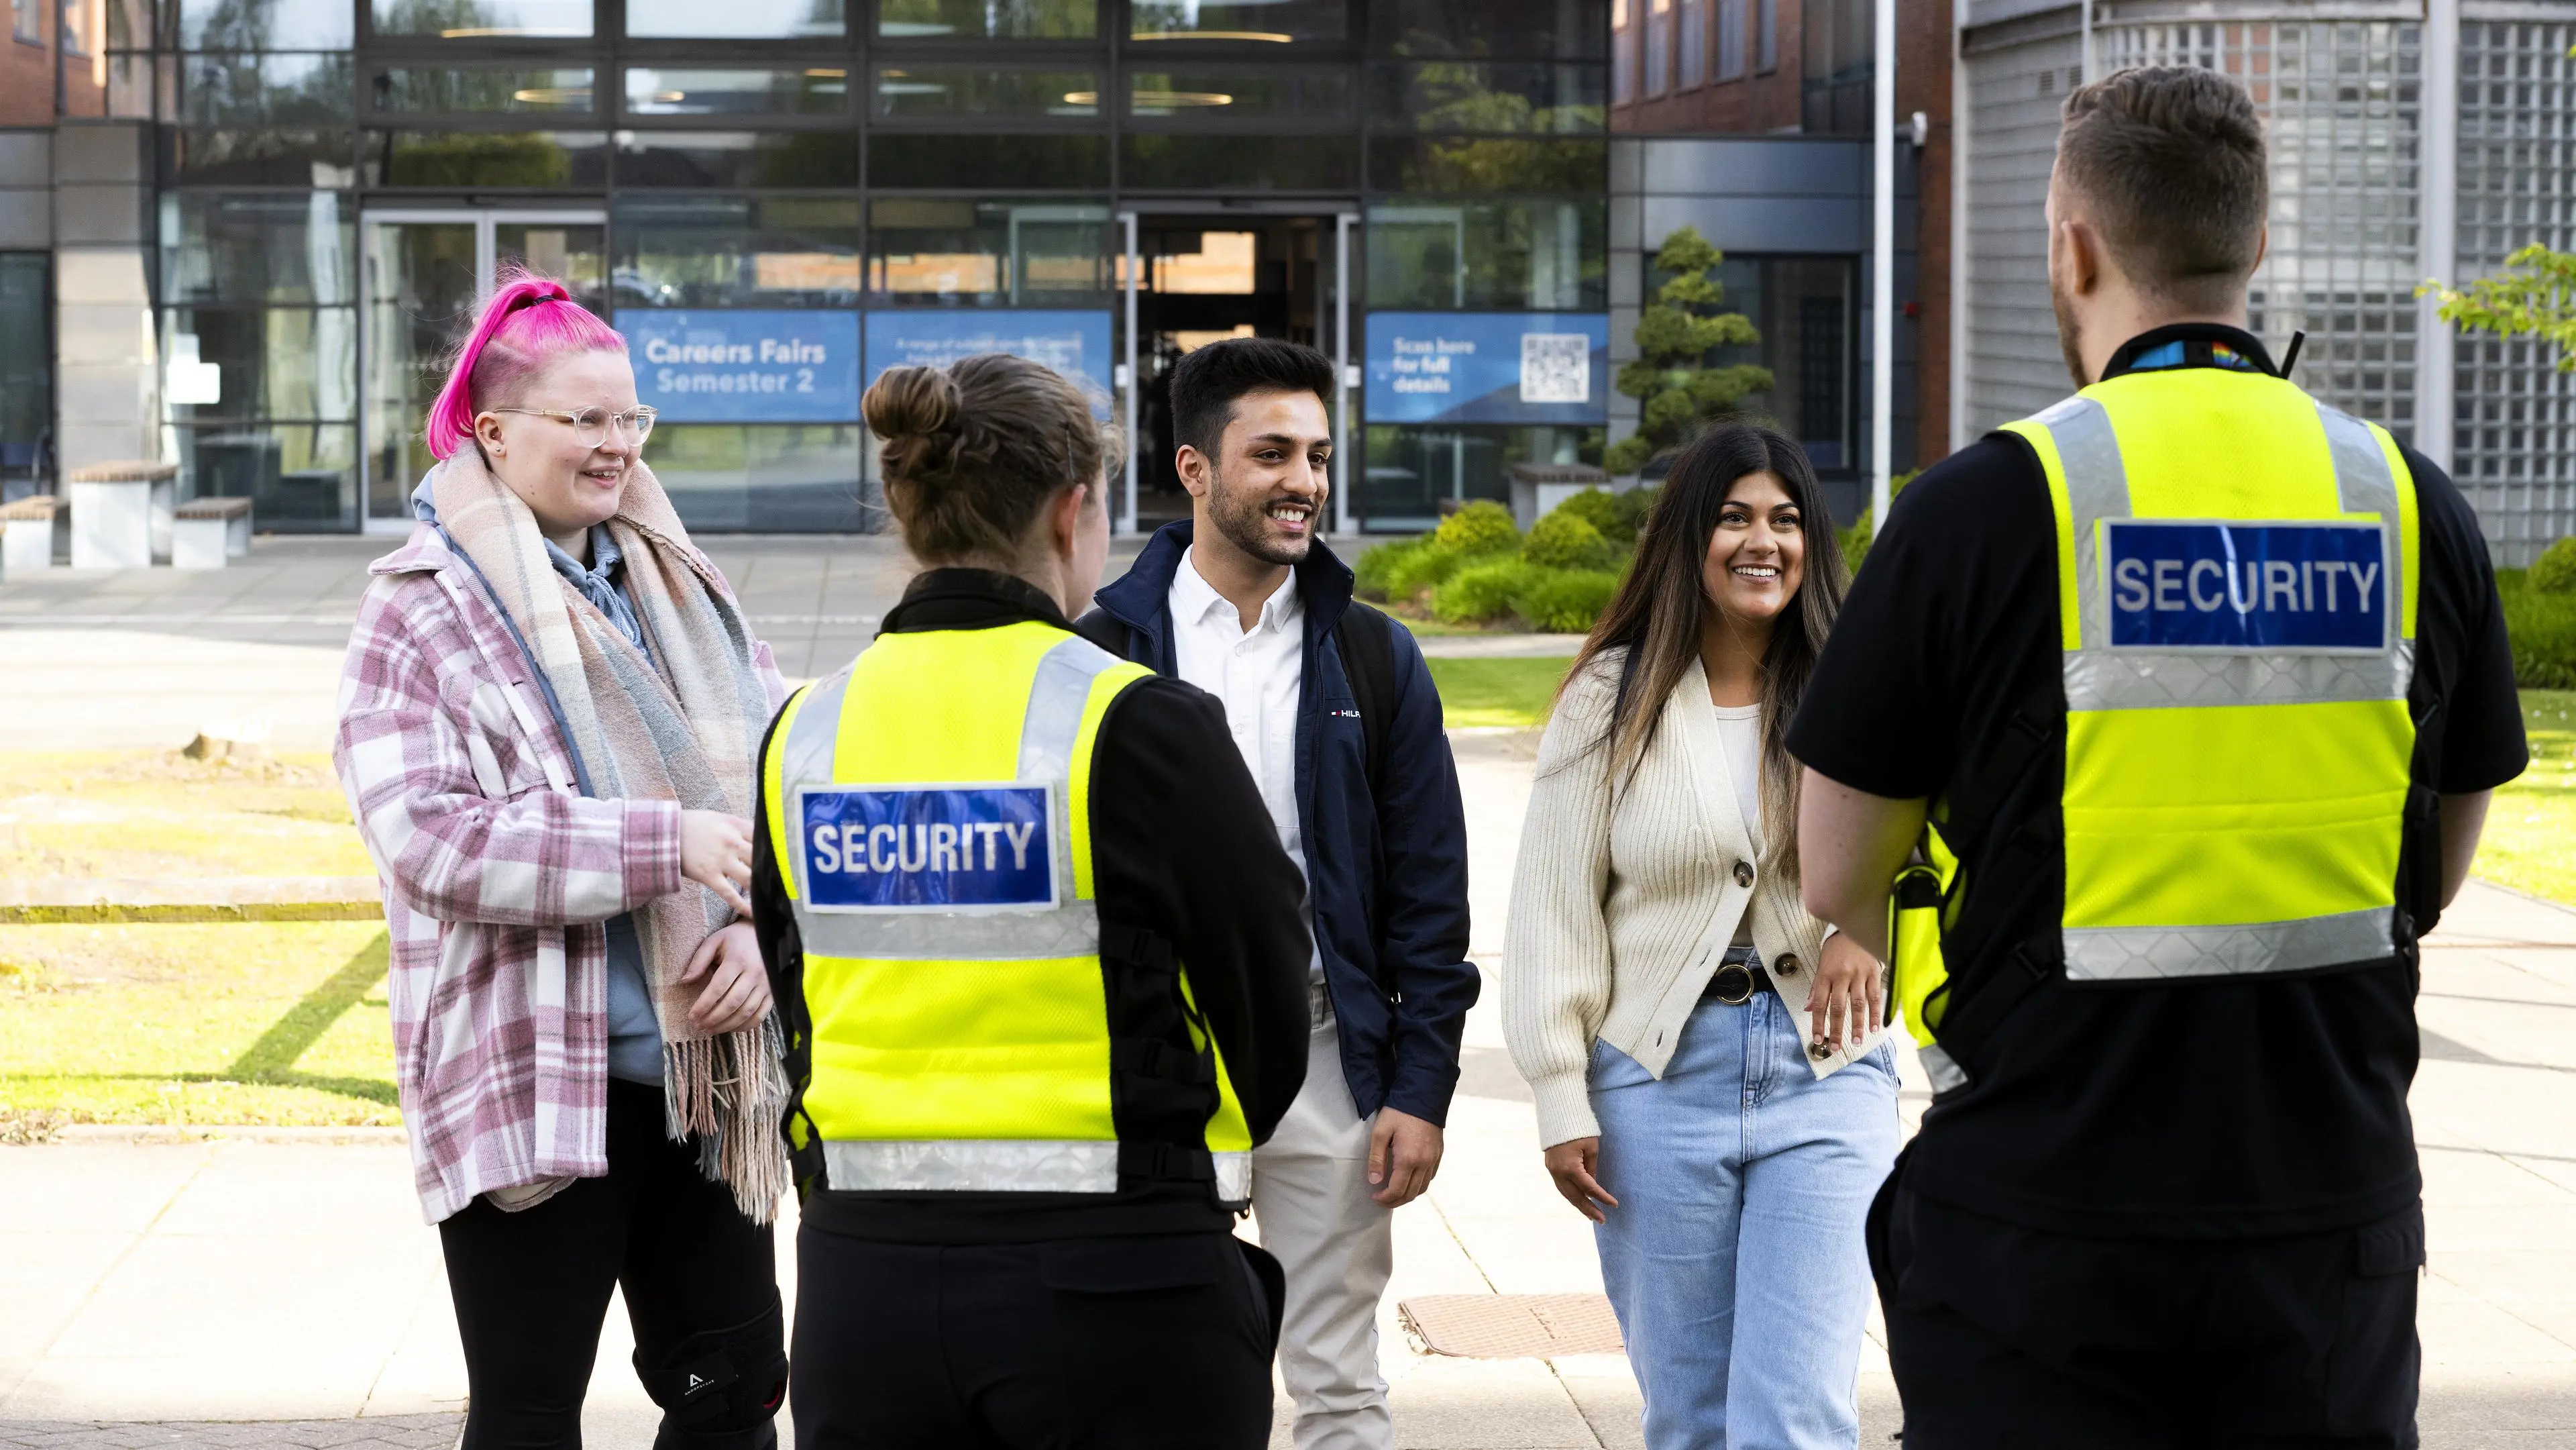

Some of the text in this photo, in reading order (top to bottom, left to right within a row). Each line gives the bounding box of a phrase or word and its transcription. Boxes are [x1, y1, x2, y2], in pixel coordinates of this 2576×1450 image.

[645, 338, 826, 364] Careers Fairs
[1393, 336, 1475, 355] Scan here
[1393, 355, 1450, 374] for full
[657, 368, 814, 393] Semester 2
[1393, 375, 1450, 393] details
[2114, 558, 2379, 614] SECURITY
[812, 821, 1036, 874] SECURITY
